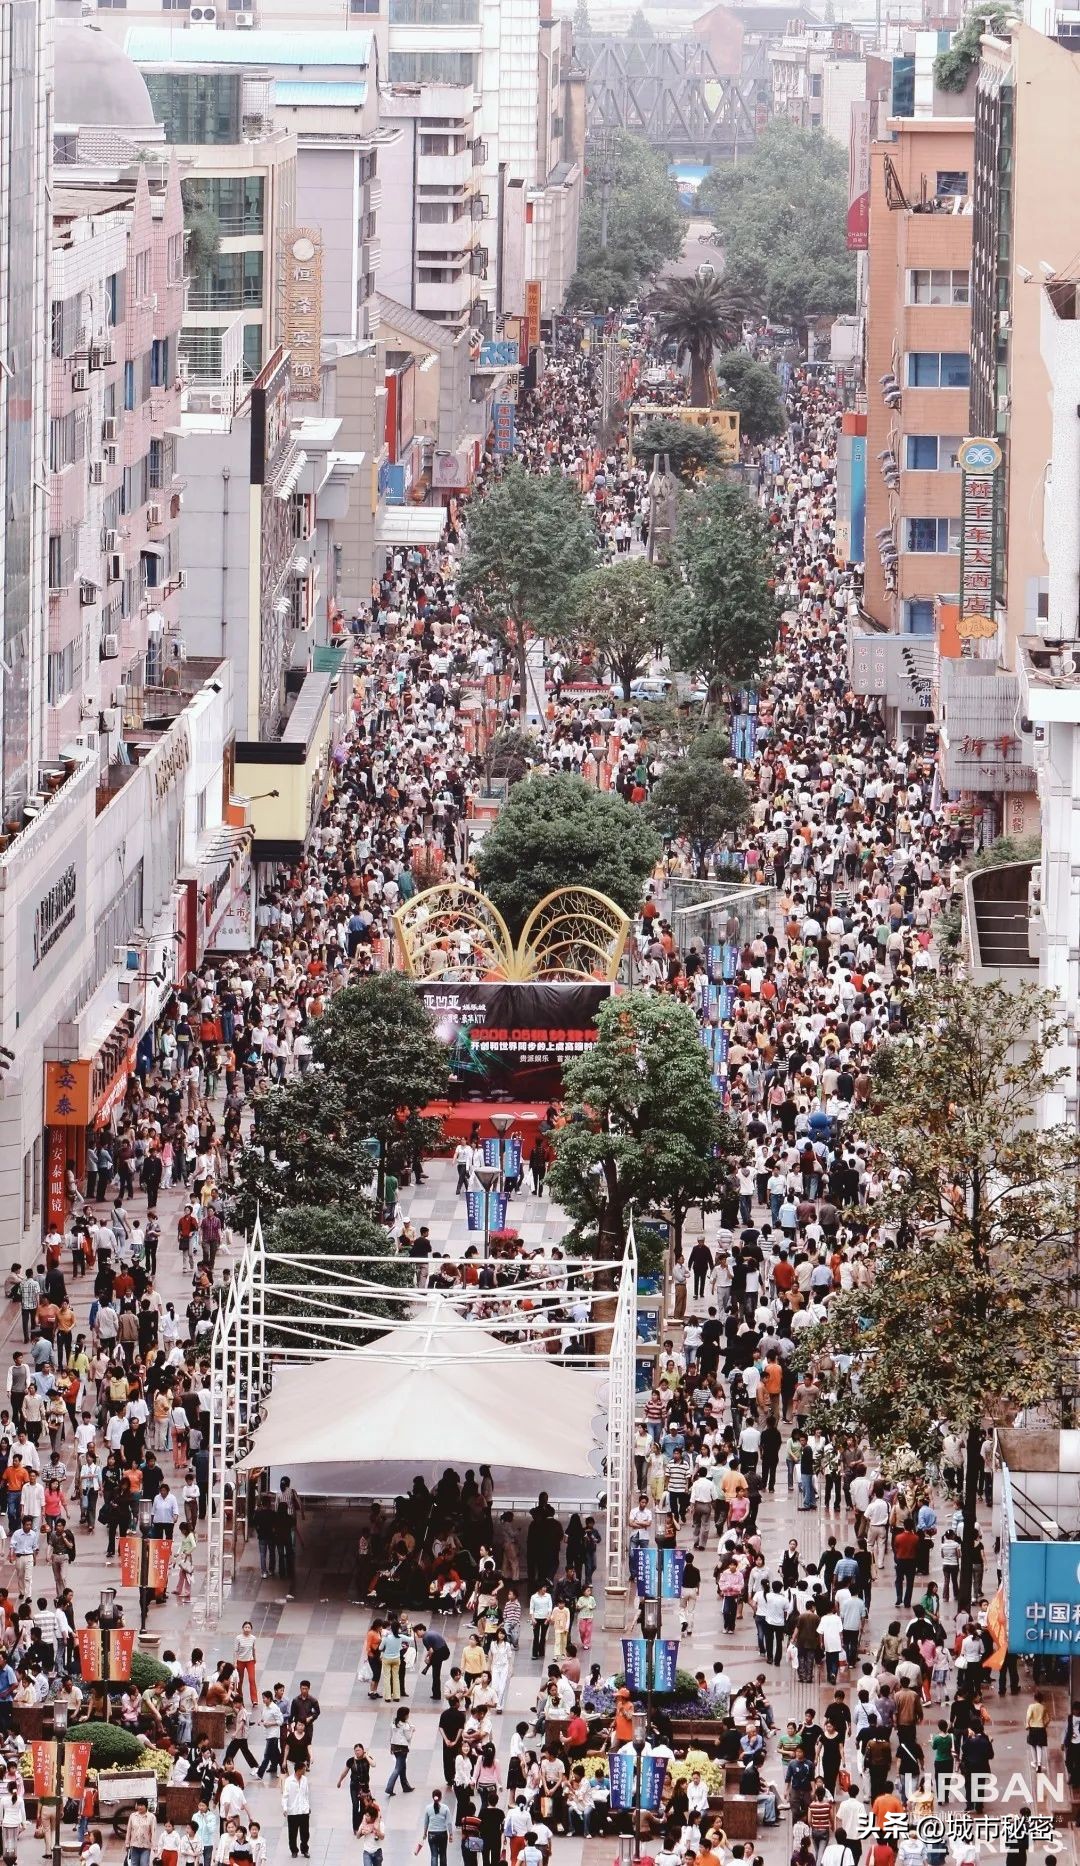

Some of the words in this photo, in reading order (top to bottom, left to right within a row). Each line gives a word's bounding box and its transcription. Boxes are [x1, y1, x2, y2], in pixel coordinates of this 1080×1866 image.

[963, 481, 992, 613] 新千年大酒店
[1012, 799, 1024, 833] 快餐
[55, 1069, 77, 1116] 安泰
